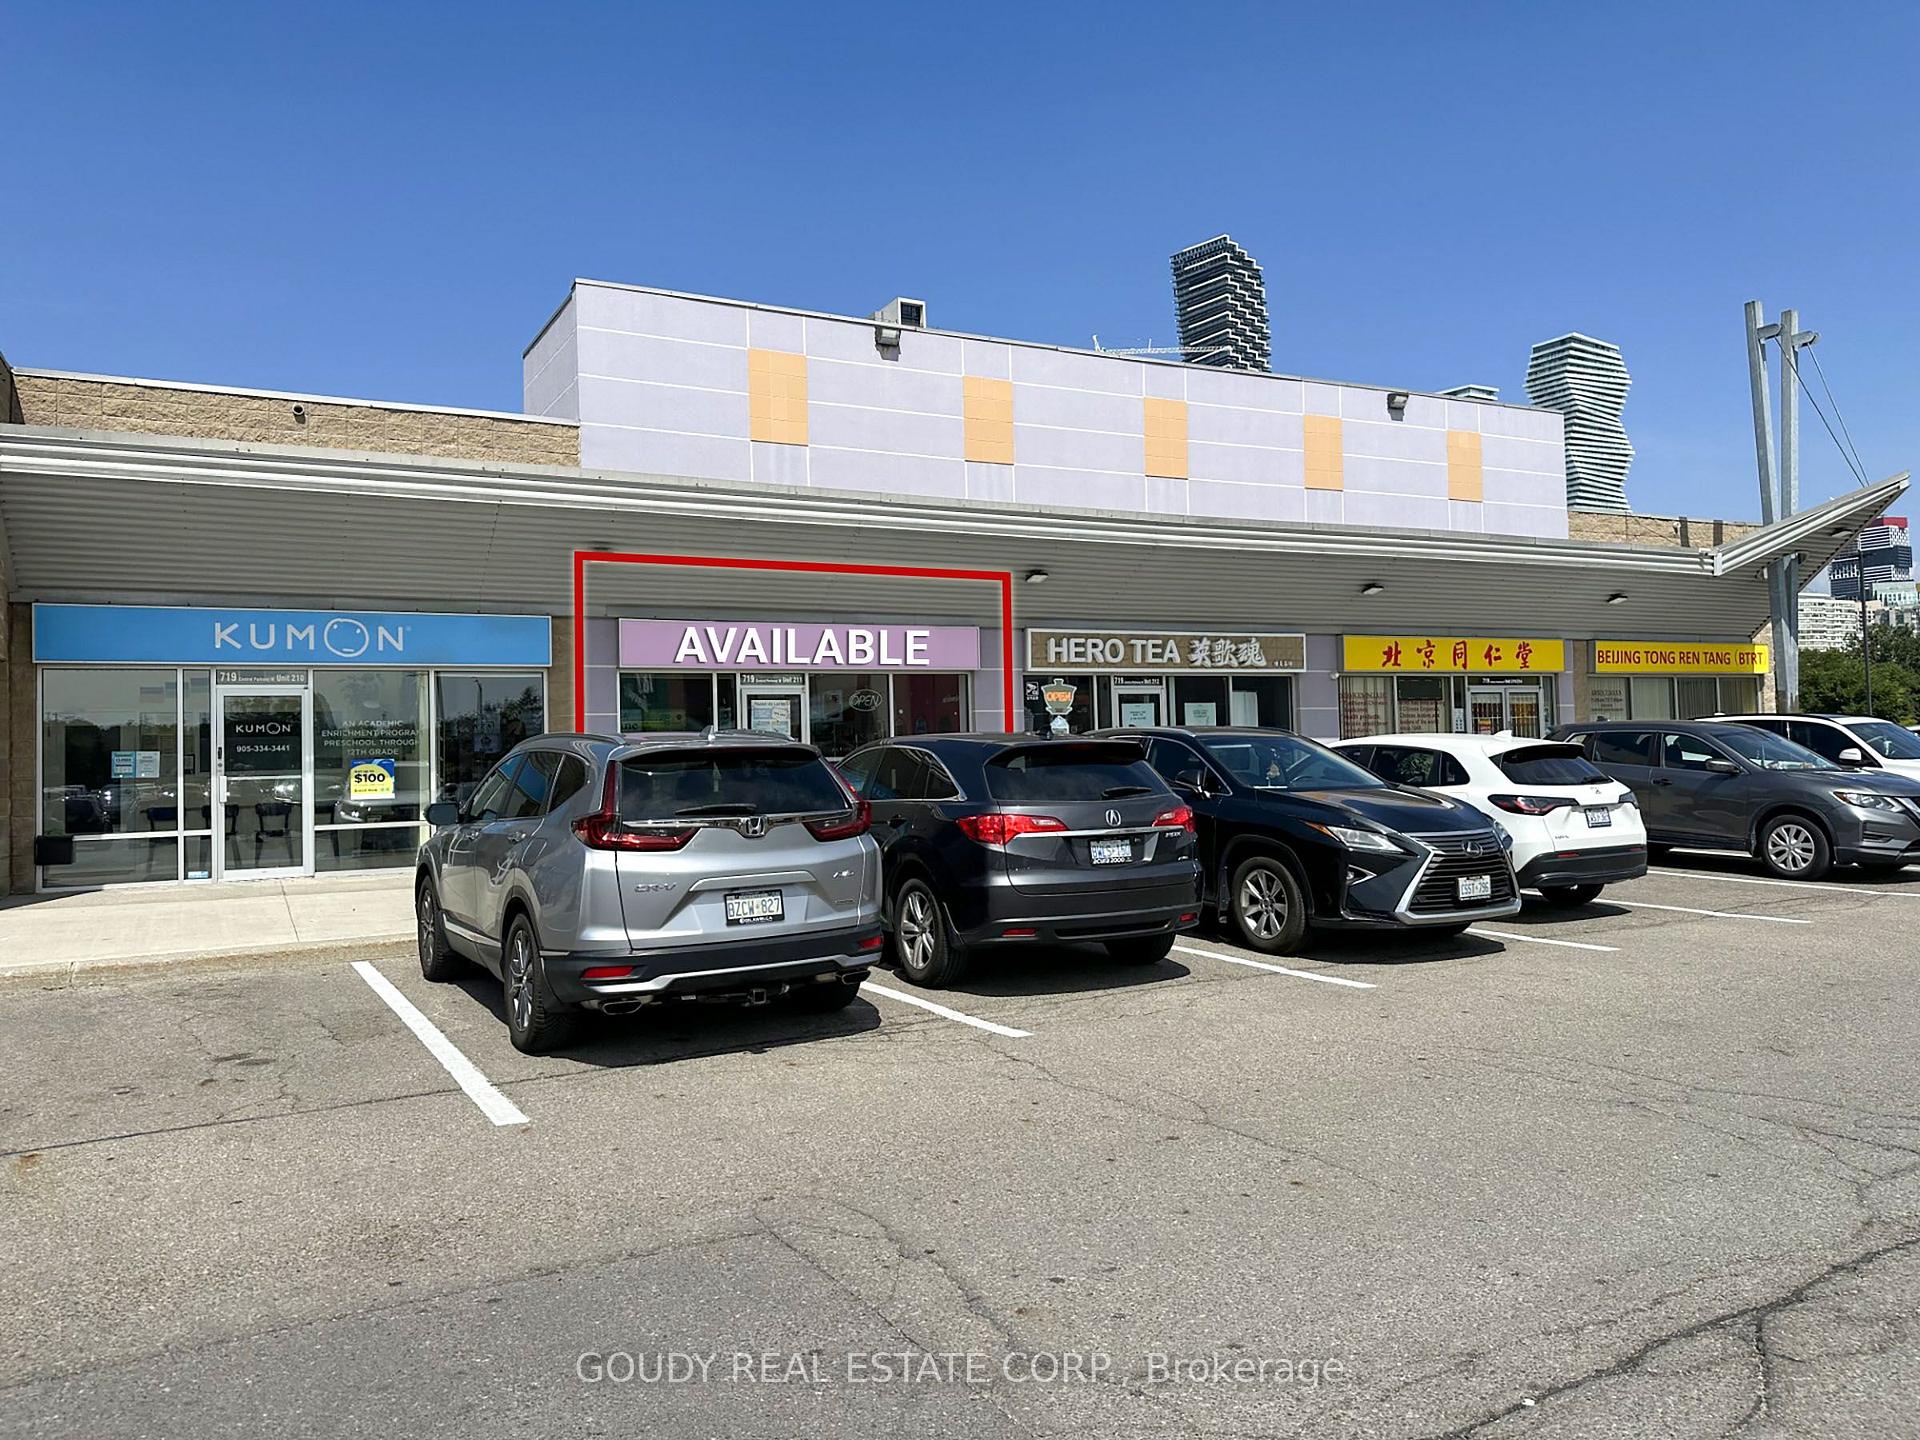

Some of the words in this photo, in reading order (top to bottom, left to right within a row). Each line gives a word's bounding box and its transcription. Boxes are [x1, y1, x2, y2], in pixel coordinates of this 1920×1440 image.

[215, 618, 404, 657] KUMON
[674, 626, 930, 666] AVAILABLE
[1047, 637, 1125, 663] HERO
[1128, 639, 1181, 664] TEA
[1382, 639, 1533, 670] 北京同仁堂
[1597, 649, 1641, 664] BEIJING
[1643, 650, 1676, 665] TONG
[1678, 651, 1701, 665] REN
[1702, 651, 1732, 665] TANG
[220, 671, 237, 682] 719
[235, 722, 291, 735] KUMON
[321, 729, 380, 737] ENRICHMENT
[323, 739, 377, 747] PRESCHOOL
[368, 748, 399, 756] GRADE
[354, 772, 386, 784] $100
[728, 900, 755, 918] BZCW
[760, 897, 780, 914] 827
